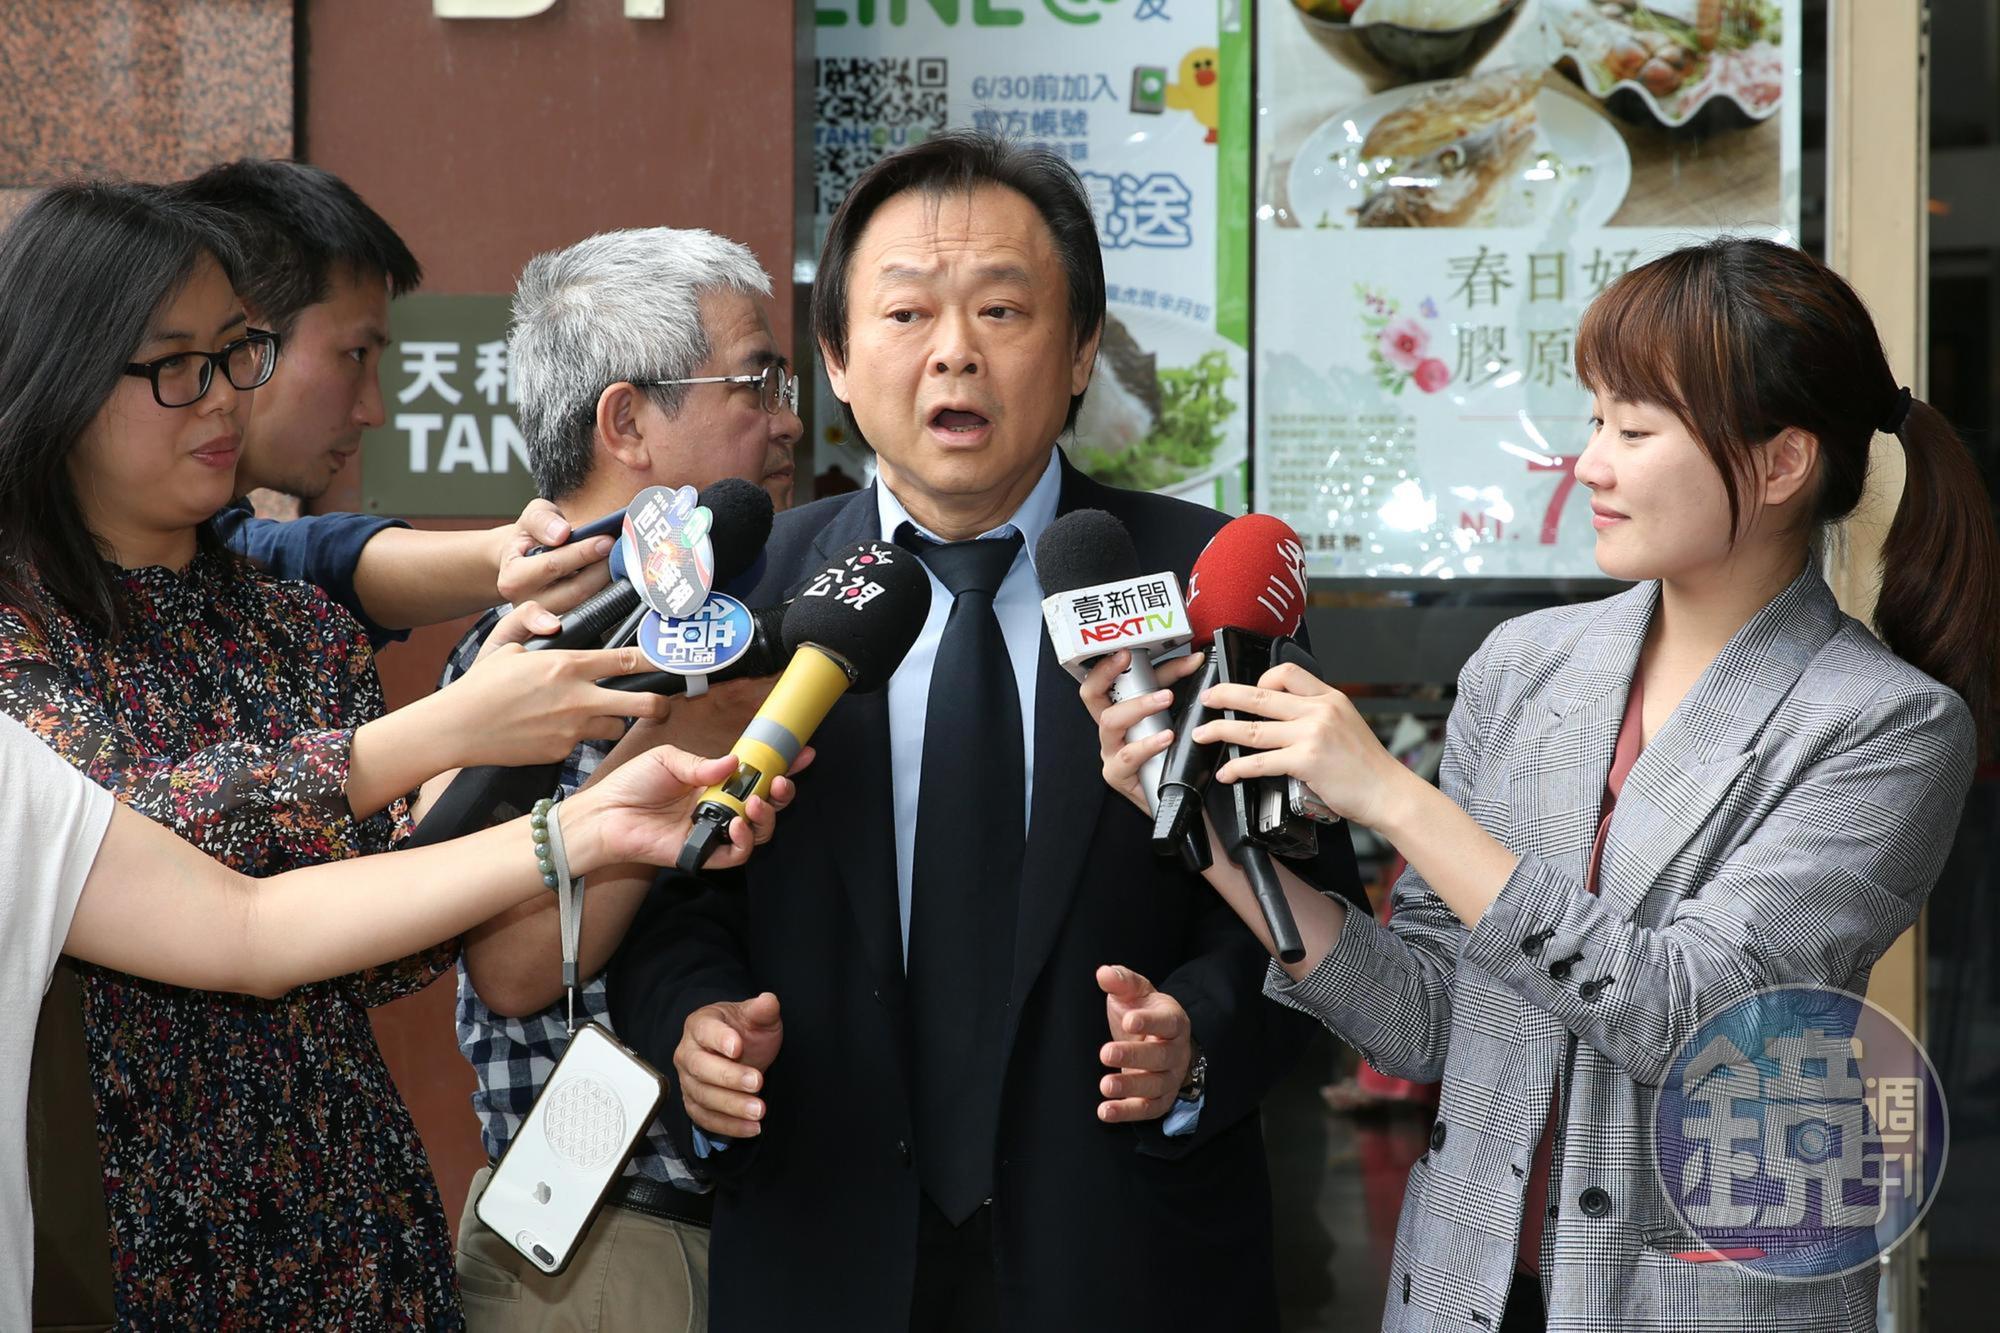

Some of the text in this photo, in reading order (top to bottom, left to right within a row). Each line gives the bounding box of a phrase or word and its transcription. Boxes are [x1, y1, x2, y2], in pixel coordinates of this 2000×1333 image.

[971, 74, 1118, 102] 6/30前加入
[1072, 580, 1171, 626] 壹新聞
